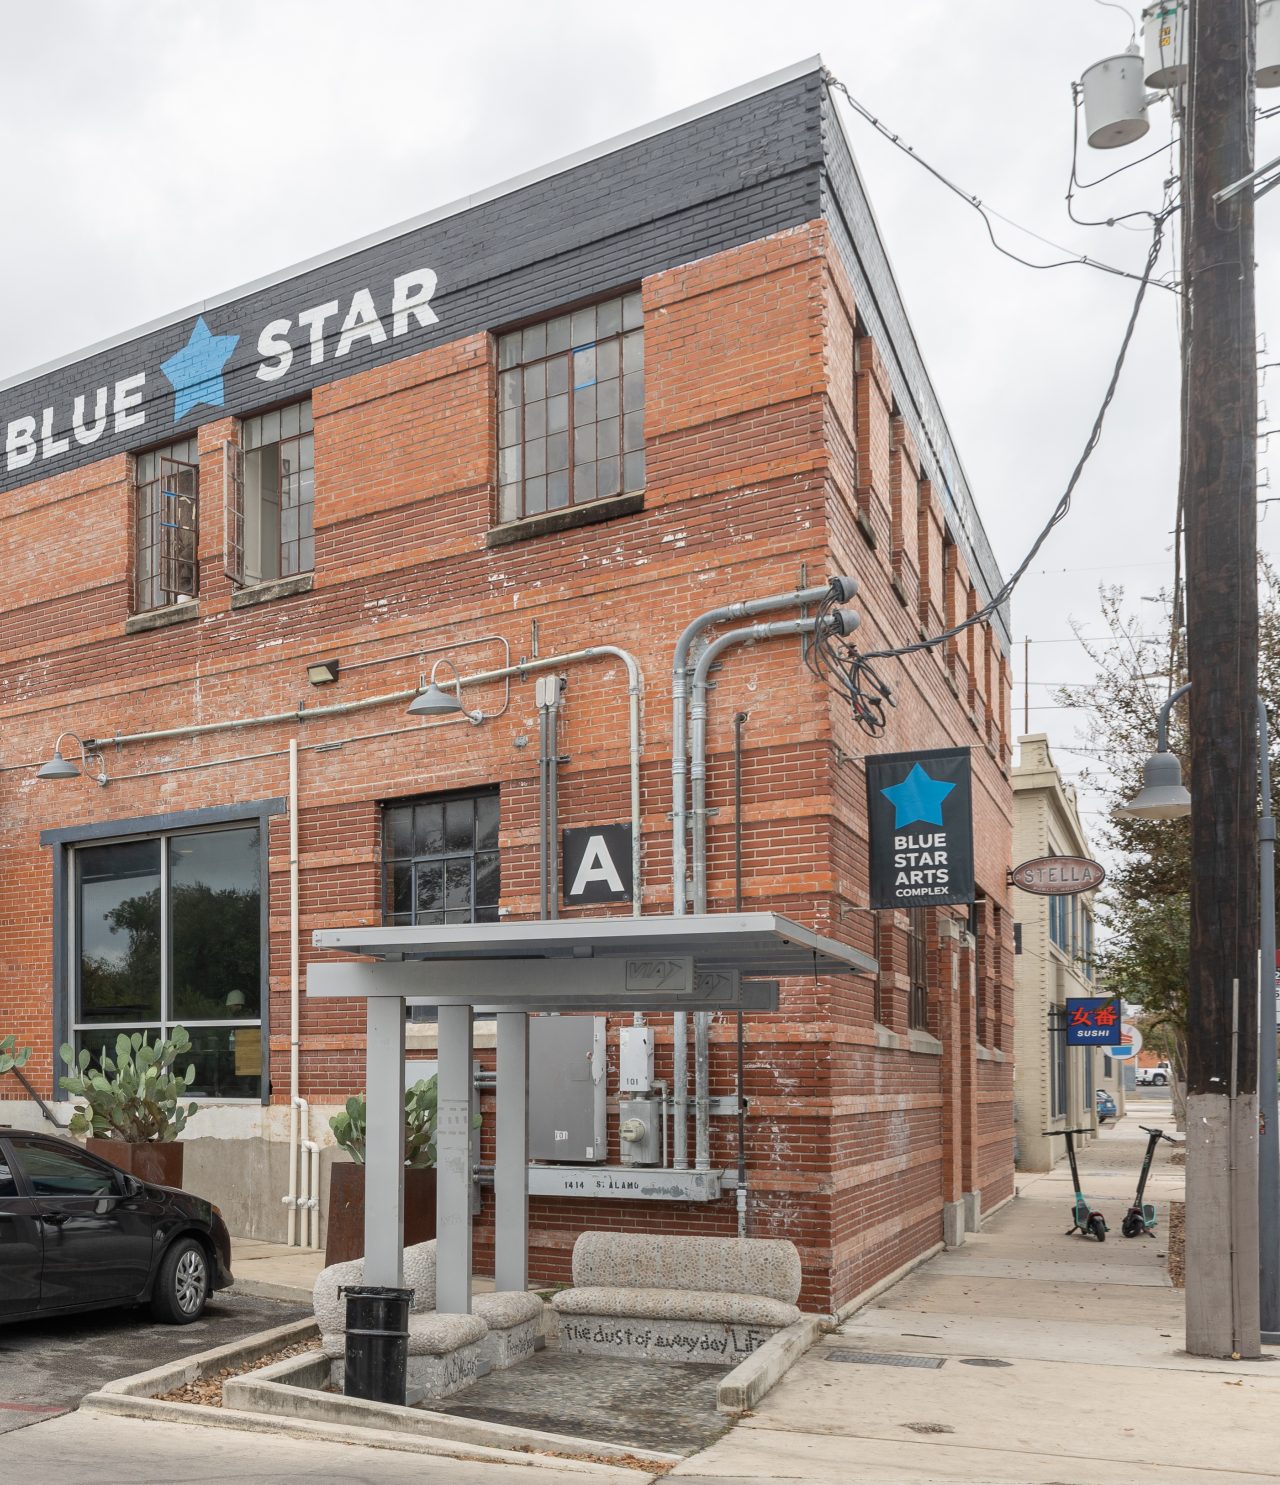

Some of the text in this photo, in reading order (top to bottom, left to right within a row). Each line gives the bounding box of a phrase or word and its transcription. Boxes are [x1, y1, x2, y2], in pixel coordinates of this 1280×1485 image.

[6, 267, 440, 472] BLUE STAR
[894, 832, 946, 850] BLUE
[569, 835, 625, 895] A
[894, 851, 948, 868] STAR
[895, 868, 949, 886] ARTS
[1023, 866, 1095, 885] STELLA
[895, 886, 949, 897] COMPLEX
[629, 961, 666, 979] VIA
[1071, 1005, 1118, 1026] 女番
[1077, 1029, 1110, 1037] SUSHI
[626, 1077, 639, 1086] 101
[564, 1181, 584, 1189] 1414
[594, 1325, 632, 1346] dust
[635, 1330, 652, 1348] of
